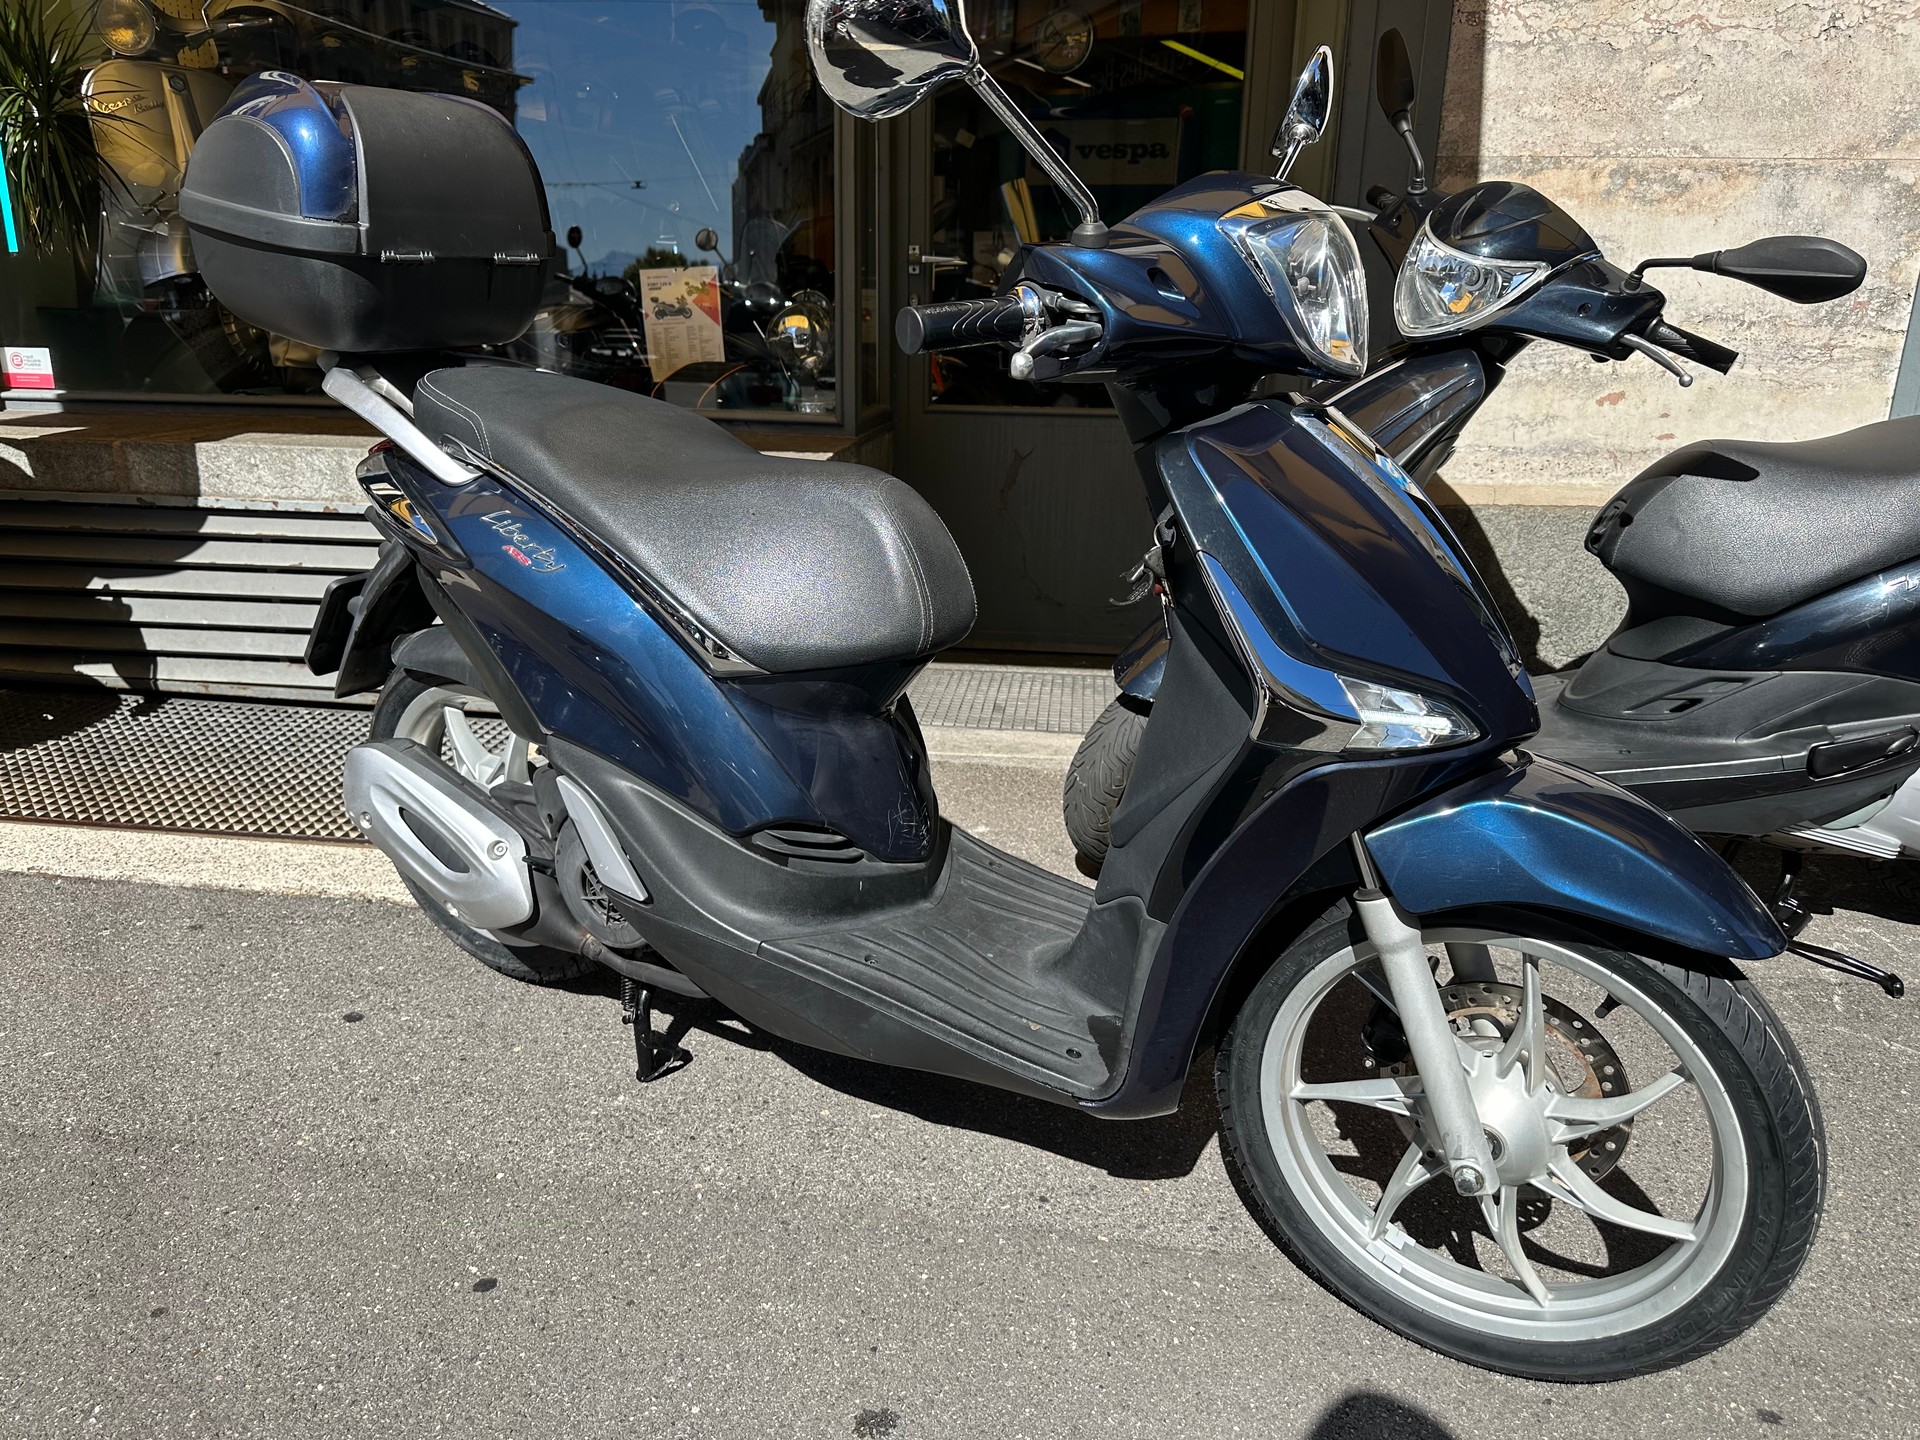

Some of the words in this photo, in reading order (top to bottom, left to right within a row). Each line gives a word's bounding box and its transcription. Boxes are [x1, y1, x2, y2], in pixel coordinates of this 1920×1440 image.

[1075, 142, 1170, 164] vespa
[479, 509, 566, 574] Liberty
[501, 544, 532, 567] ABS
